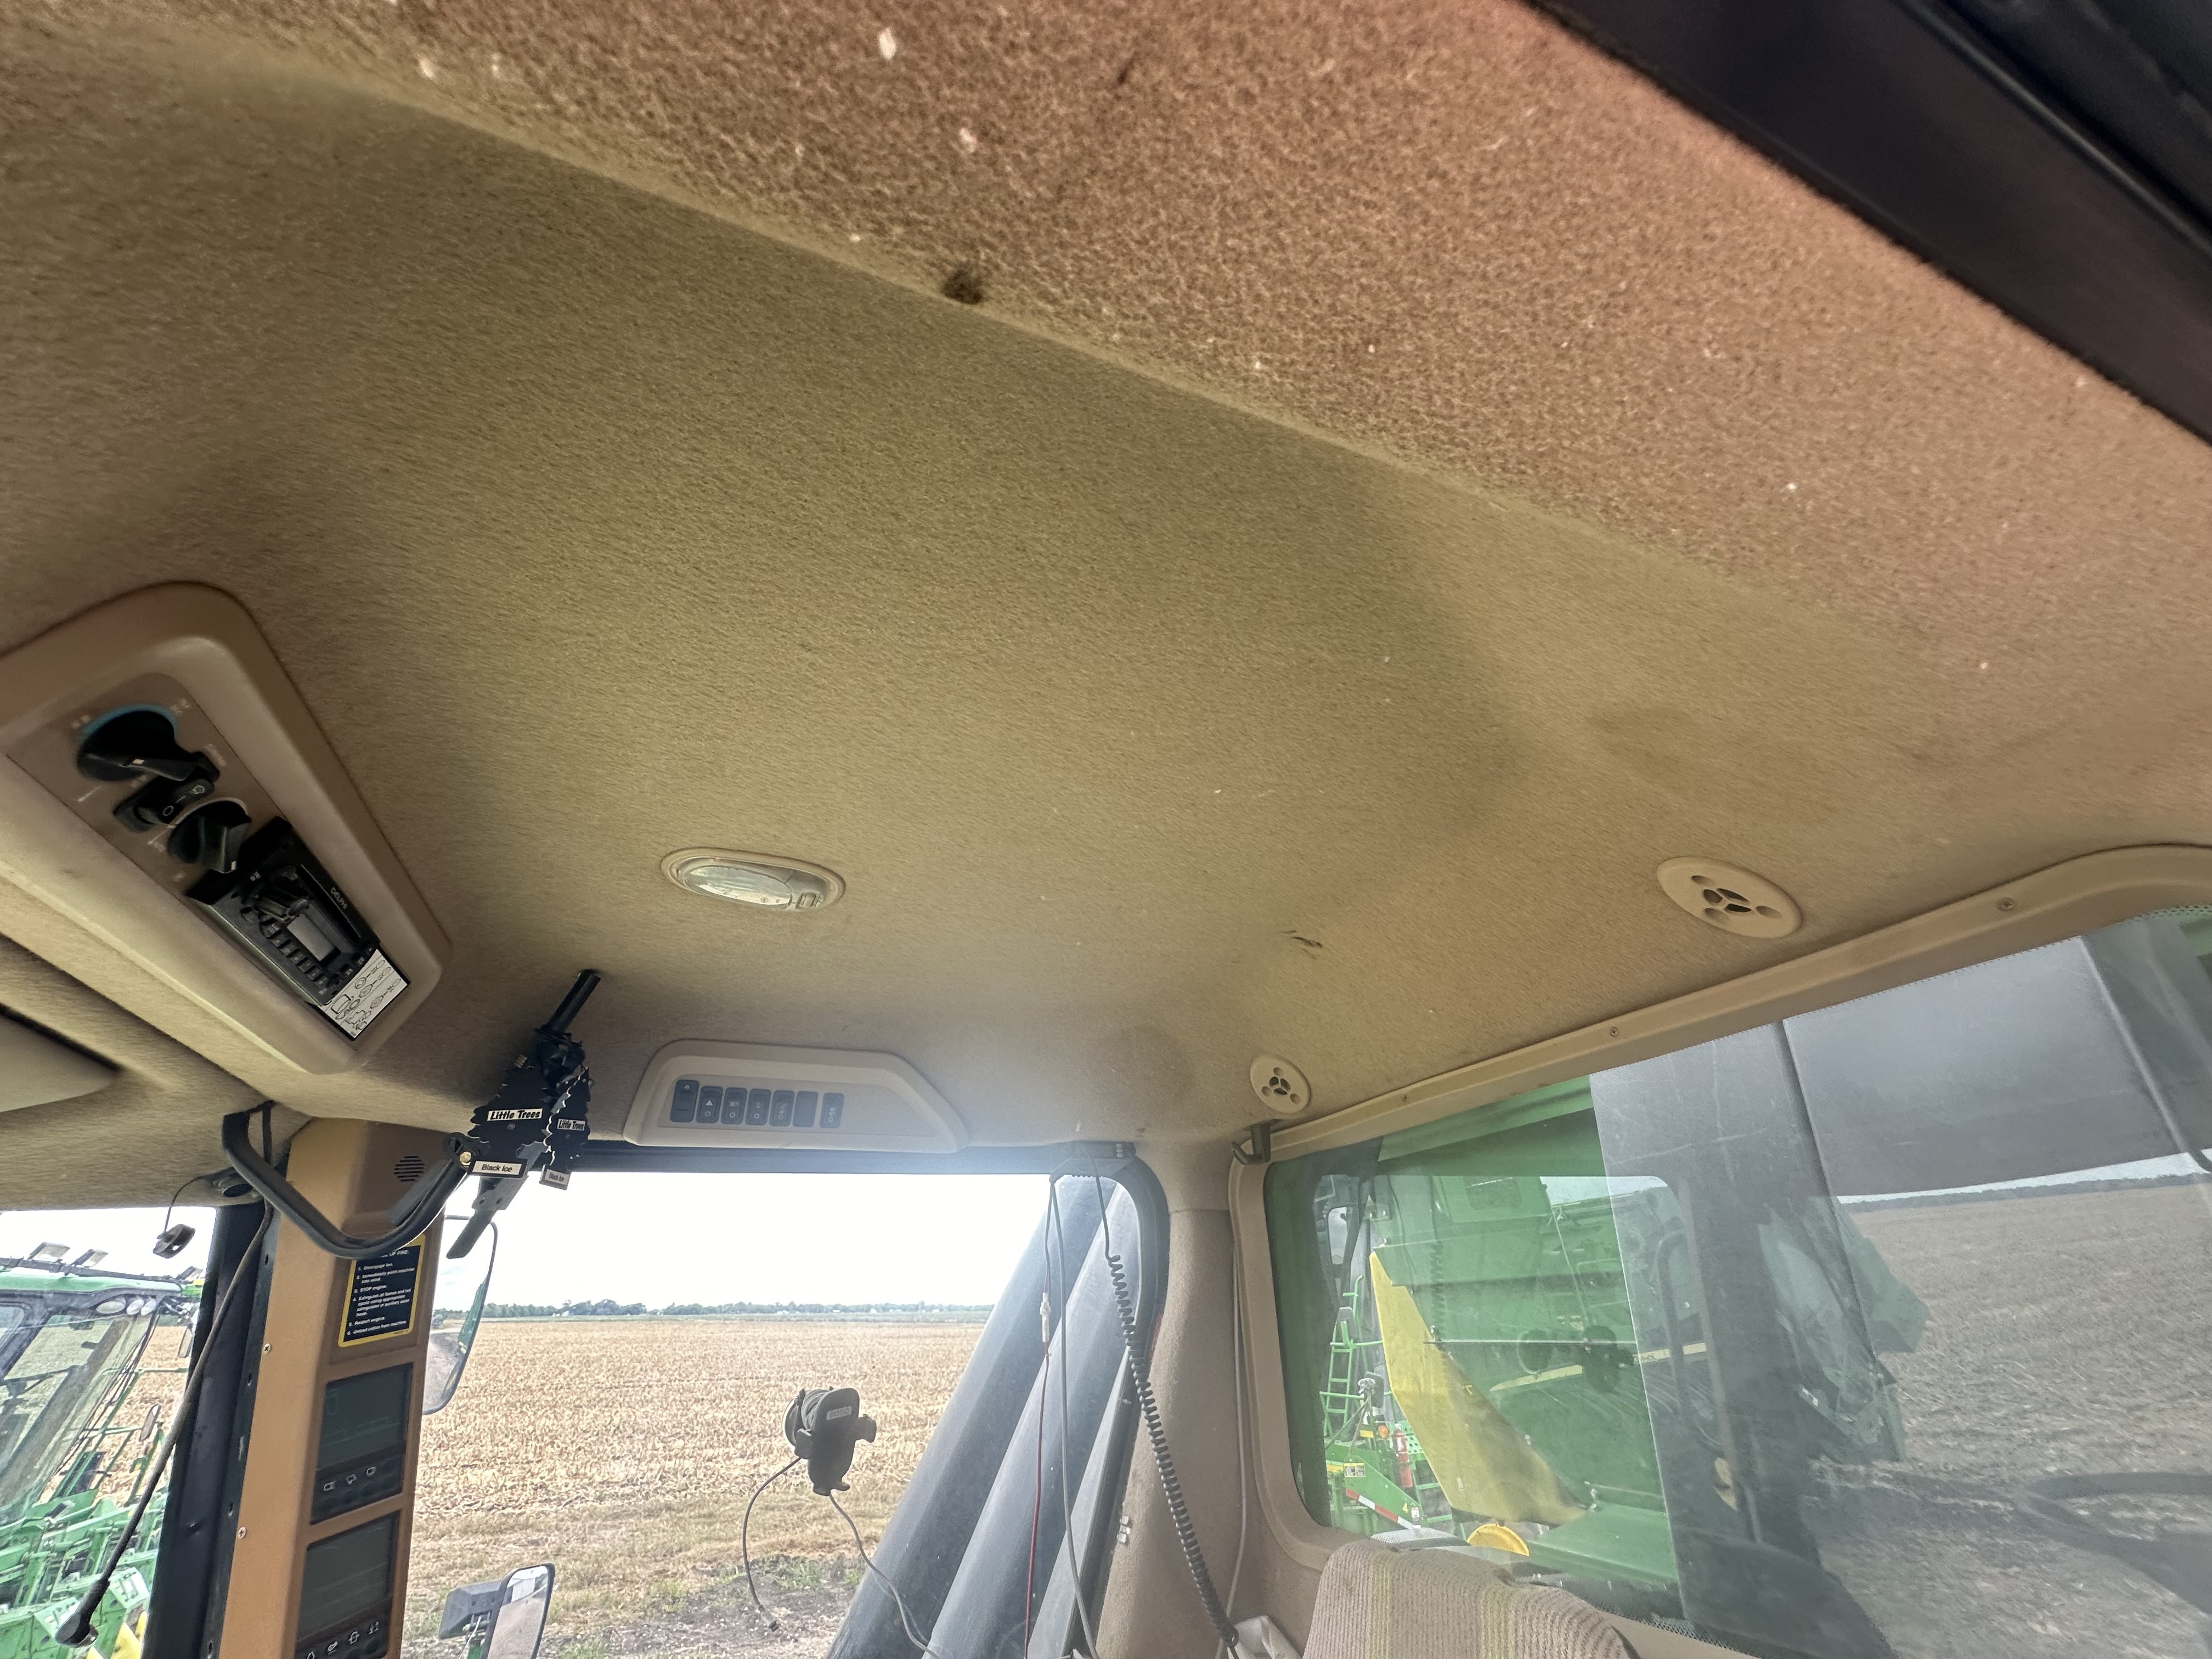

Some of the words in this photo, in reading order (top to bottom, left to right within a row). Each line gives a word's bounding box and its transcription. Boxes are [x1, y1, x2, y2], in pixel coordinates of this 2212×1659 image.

[490, 1110, 515, 1120] Little
[517, 1110, 540, 1119] Trees
[559, 1120, 571, 1128] Little
[572, 1121, 584, 1130] Trees
[1402, 1503, 1408, 1513] 4
